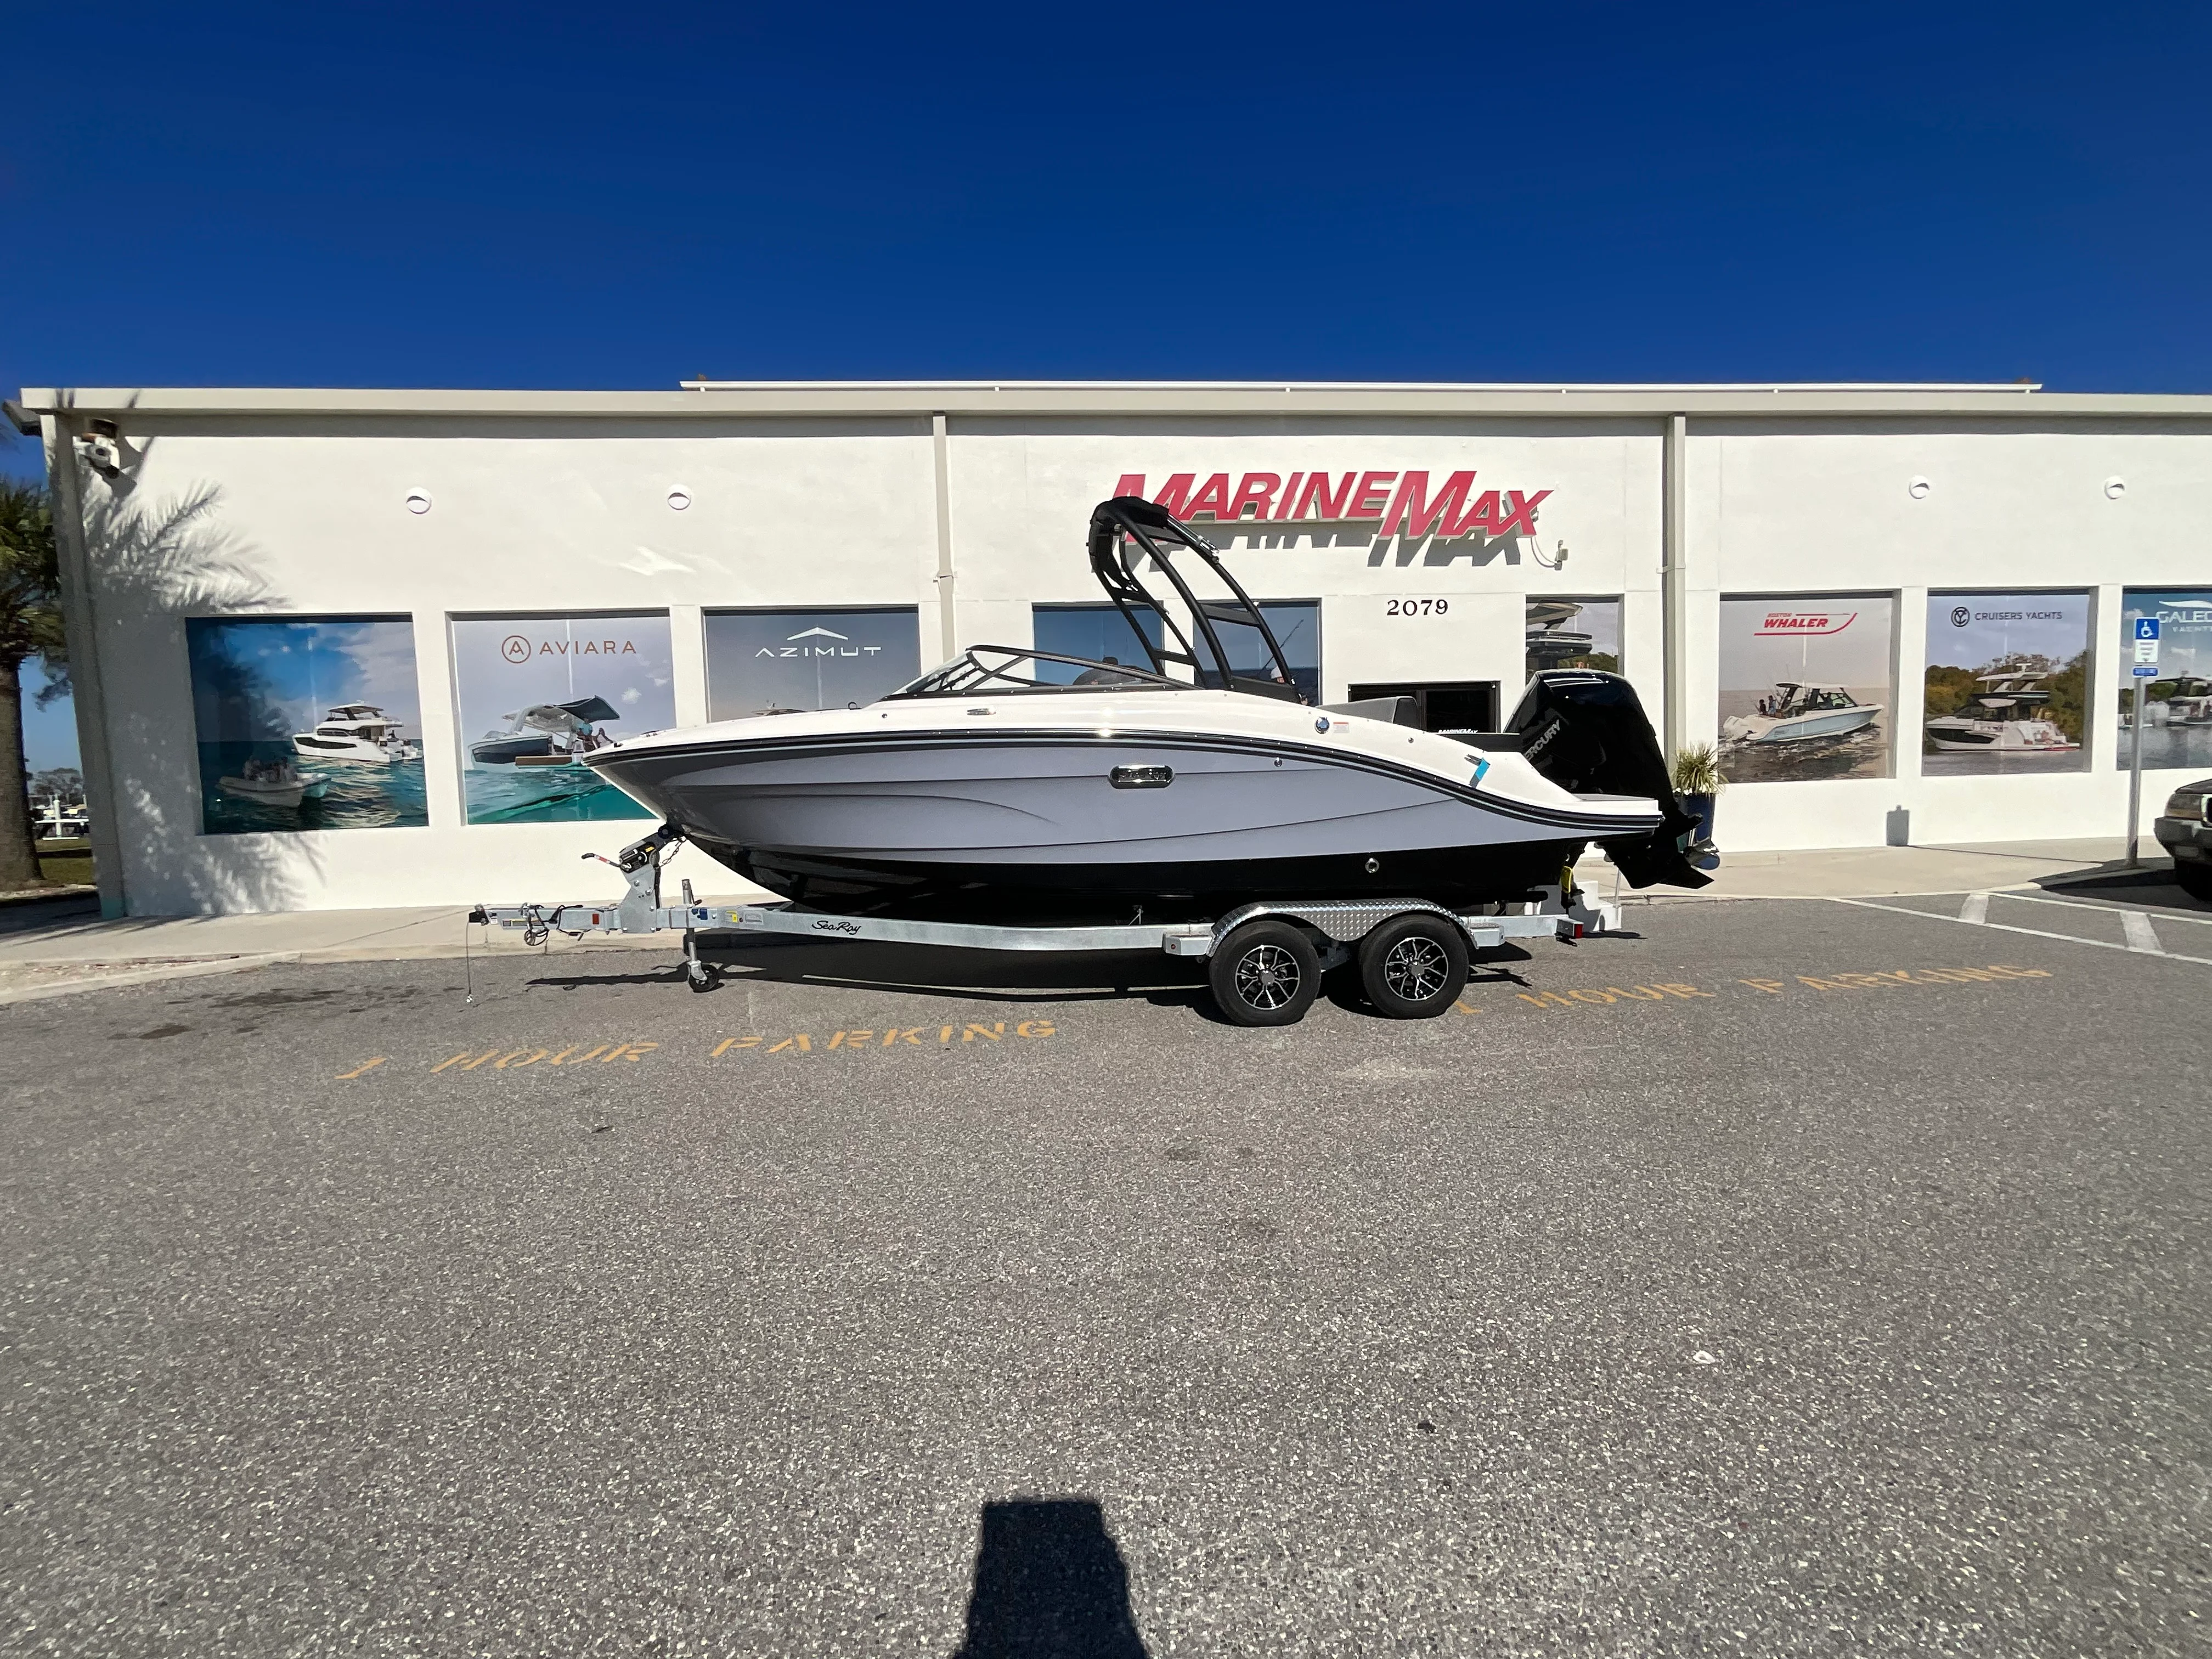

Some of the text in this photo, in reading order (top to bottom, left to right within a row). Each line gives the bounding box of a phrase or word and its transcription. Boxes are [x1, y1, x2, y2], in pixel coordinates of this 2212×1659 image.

[1386, 599, 1448, 616] 2079
[1975, 611, 2063, 620] CRUISERS YACHTS
[1763, 618, 1829, 628] WHALER
[539, 640, 637, 655] AVIARA
[755, 646, 882, 657] AZIMUT
[1523, 719, 1560, 762] ERCURY
[1515, 983, 1717, 1008] HOUR
[335, 1020, 1056, 1080] 1 HOUR PARKING
